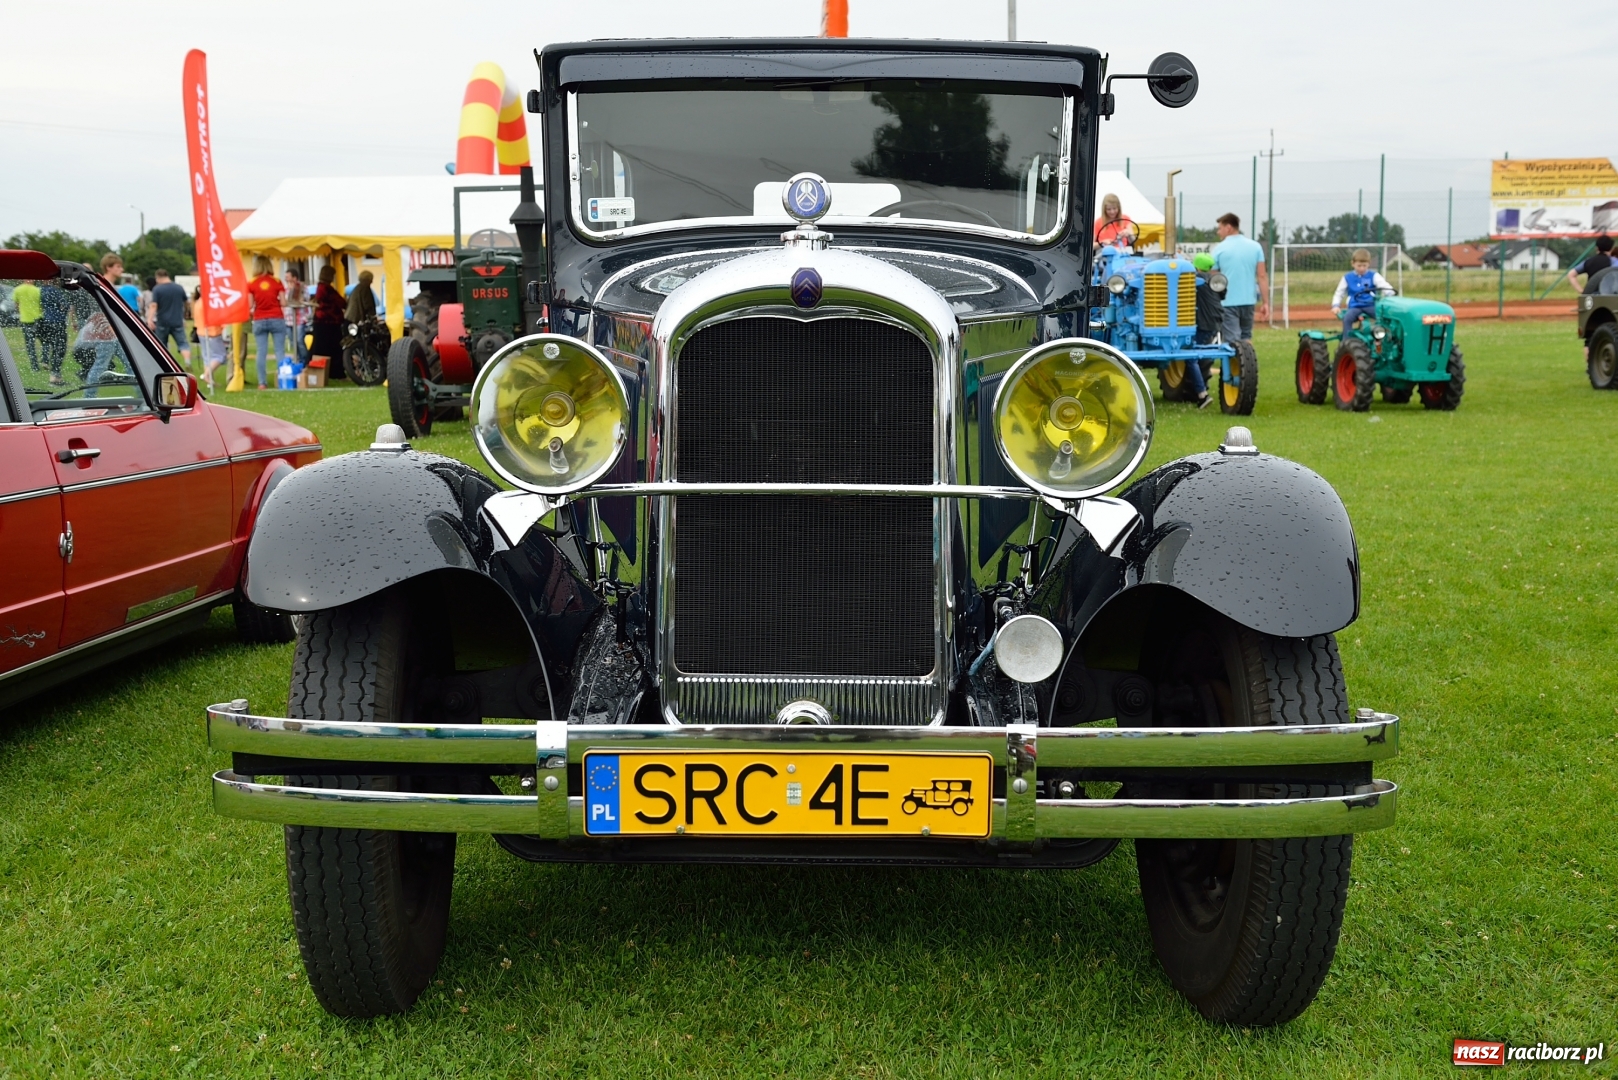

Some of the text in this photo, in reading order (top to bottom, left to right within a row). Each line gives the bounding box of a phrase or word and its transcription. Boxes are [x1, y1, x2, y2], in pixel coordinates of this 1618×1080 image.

[472, 287, 509, 299] URSUS
[633, 762, 889, 826] SRC 4E
[592, 803, 616, 821] PL
